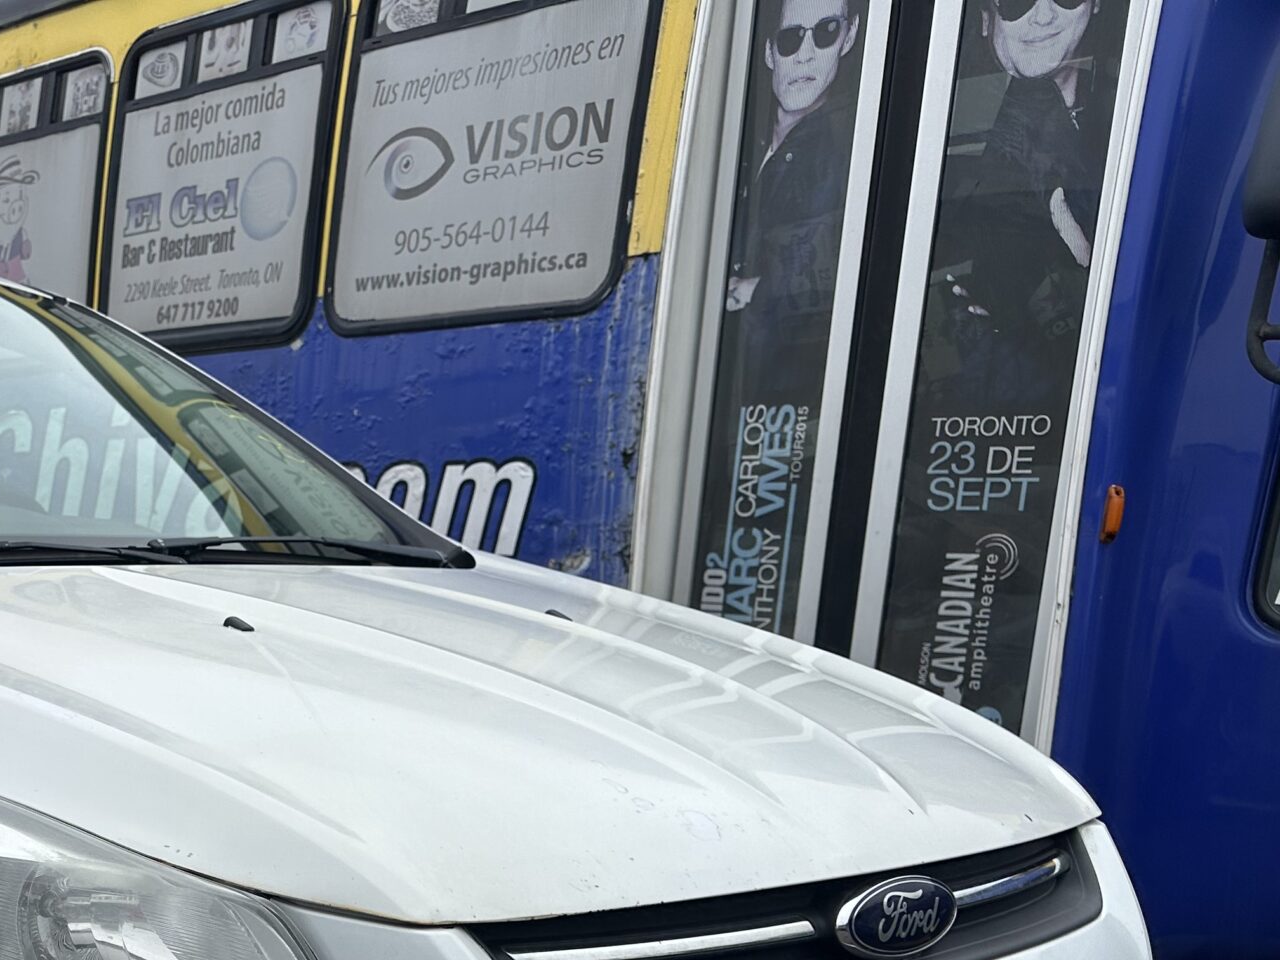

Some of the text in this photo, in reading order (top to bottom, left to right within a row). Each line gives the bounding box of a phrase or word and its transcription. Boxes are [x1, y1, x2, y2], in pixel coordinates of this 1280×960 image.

[372, 33, 625, 108] Tus mejores impresiones en
[154, 82, 286, 136] La mejor comida
[167, 130, 262, 168] Colombiana
[466, 98, 615, 165] VISION
[463, 149, 604, 184] GRAPHICS
[122, 226, 236, 269] Bar & Restaurant
[394, 211, 550, 256] 905-564-0144
[125, 280, 150, 303] 2290
[151, 277, 179, 299] Keele
[264, 261, 284, 284] ON
[355, 251, 588, 293] www.vision-graphics.ca
[157, 296, 240, 324] 647 717 9200
[931, 415, 1051, 437] TORONTO
[735, 404, 767, 518] CARLOS
[754, 404, 796, 518] VIVES
[927, 441, 1035, 475] 23 DE
[927, 477, 1040, 511] SEPT
[929, 552, 980, 688] CANADIAN
[969, 553, 999, 690] amphitheatre
[919, 642, 931, 686] MOLSON
[878, 889, 940, 943] Ford
